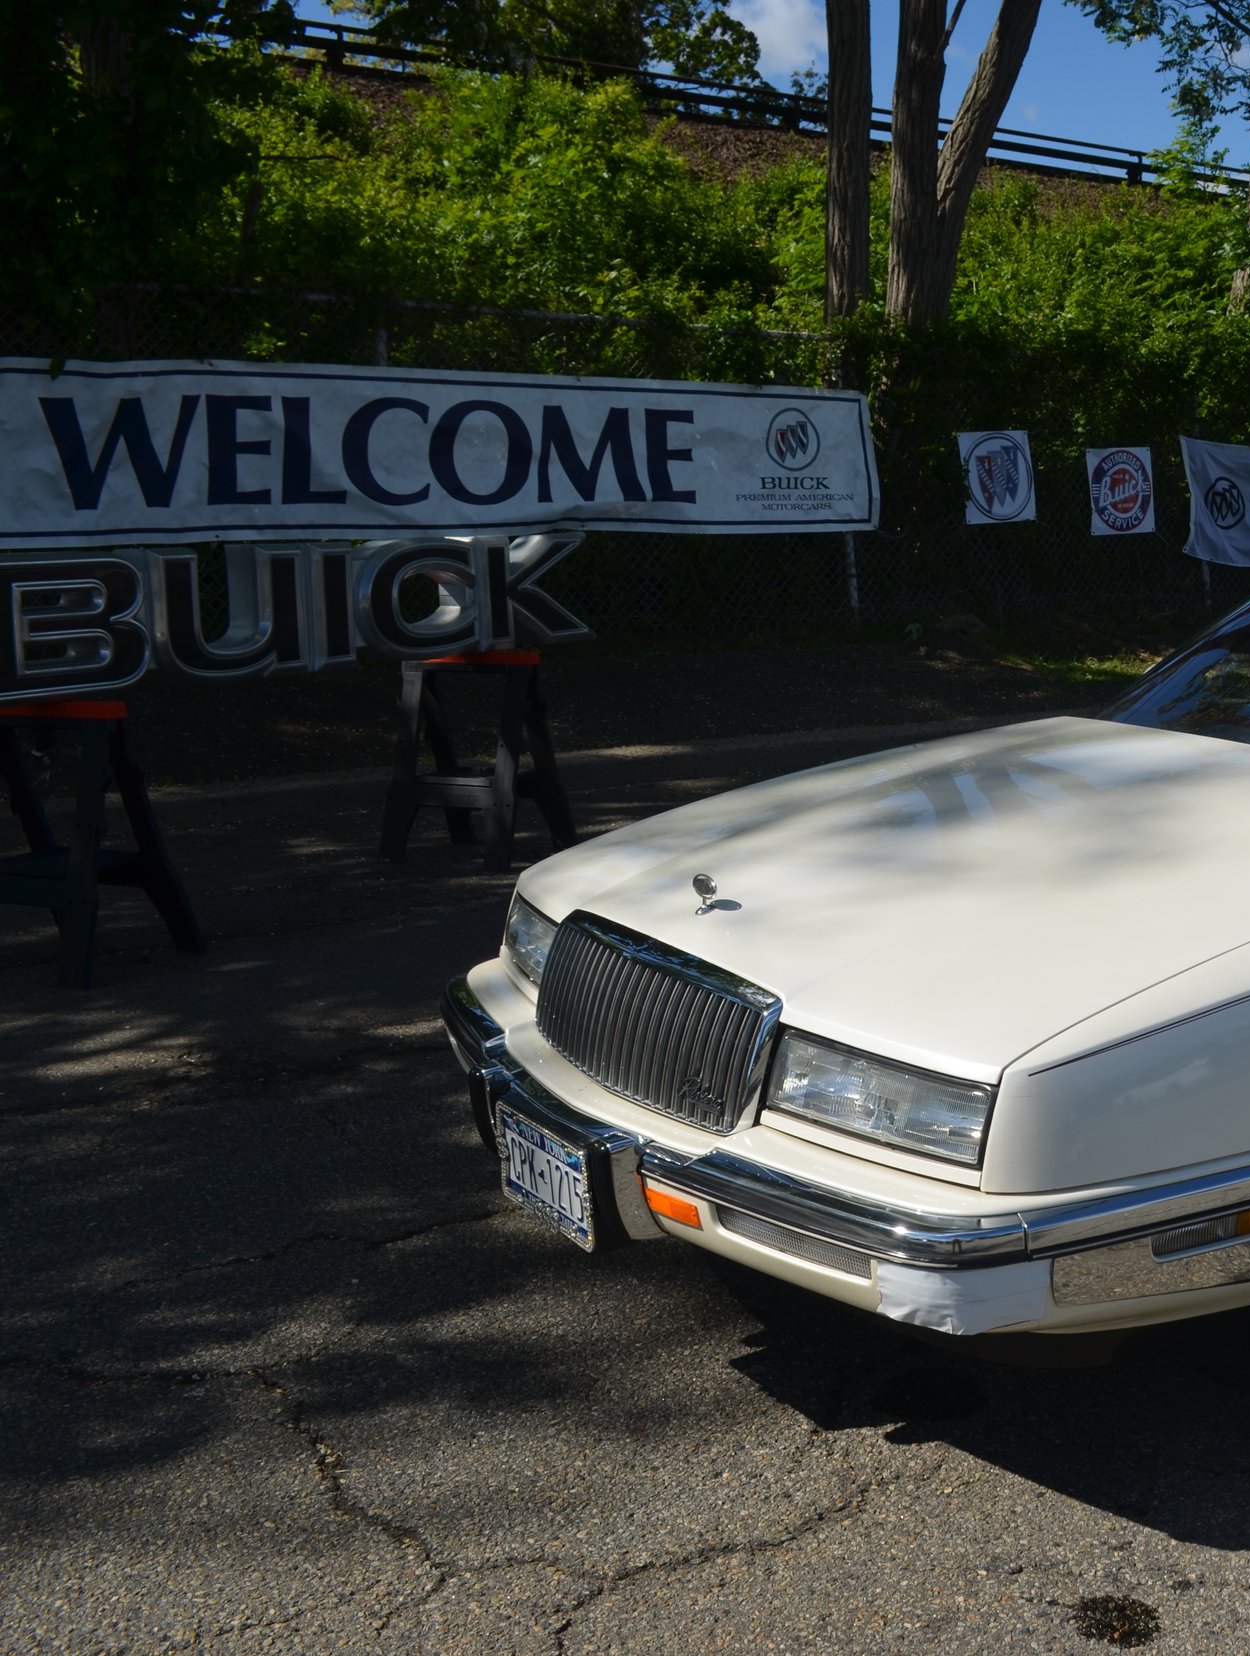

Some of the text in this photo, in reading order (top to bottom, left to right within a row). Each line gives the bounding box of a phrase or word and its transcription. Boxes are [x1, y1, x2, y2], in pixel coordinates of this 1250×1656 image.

[38, 394, 696, 511] WELCOME
[1101, 452, 1141, 472] AUTHORIZED
[759, 476, 831, 490] BUICK
[1098, 469, 1147, 508] Buick
[736, 493, 855, 502] PREMIUM AMERICAN
[761, 502, 832, 511] MOTORCARS
[1101, 508, 1145, 529] SERVICE
[0, 532, 597, 700] BUICK
[521, 1124, 568, 1164] NEW YORK
